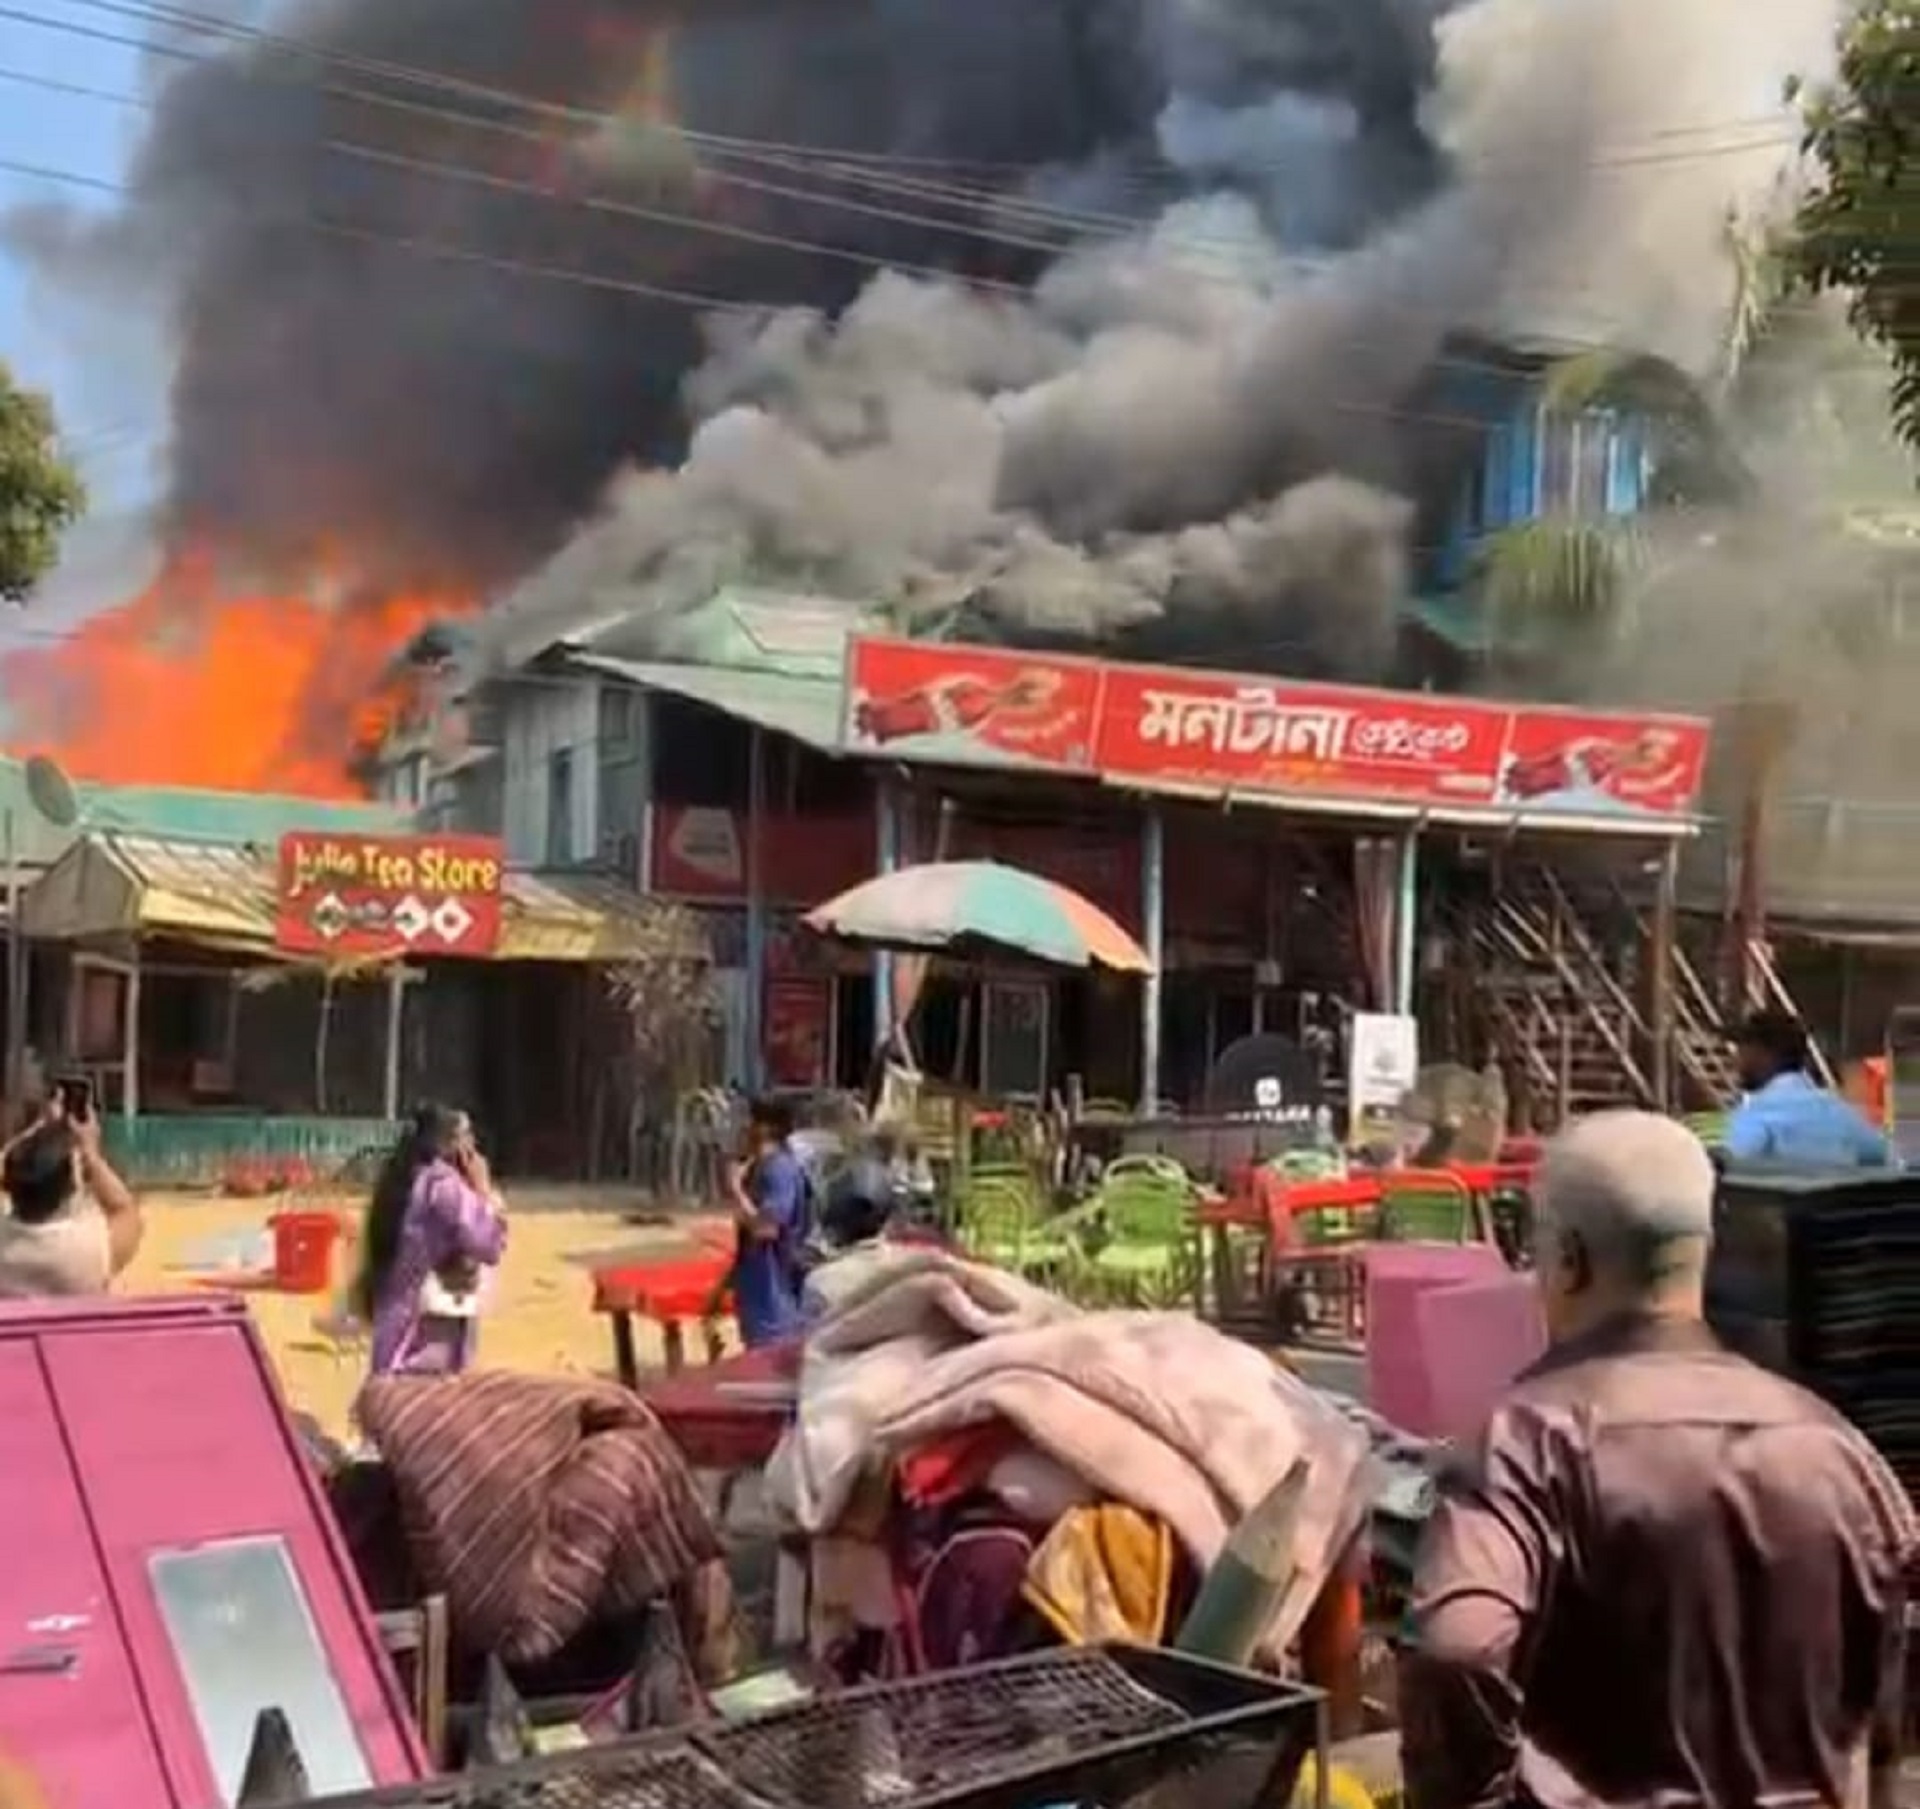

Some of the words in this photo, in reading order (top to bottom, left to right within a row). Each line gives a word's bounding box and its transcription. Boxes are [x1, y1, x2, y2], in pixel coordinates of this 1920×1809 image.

[1139, 687, 1350, 760] মনটানা
[361, 844, 414, 889] Tea
[417, 846, 498, 891] Store
